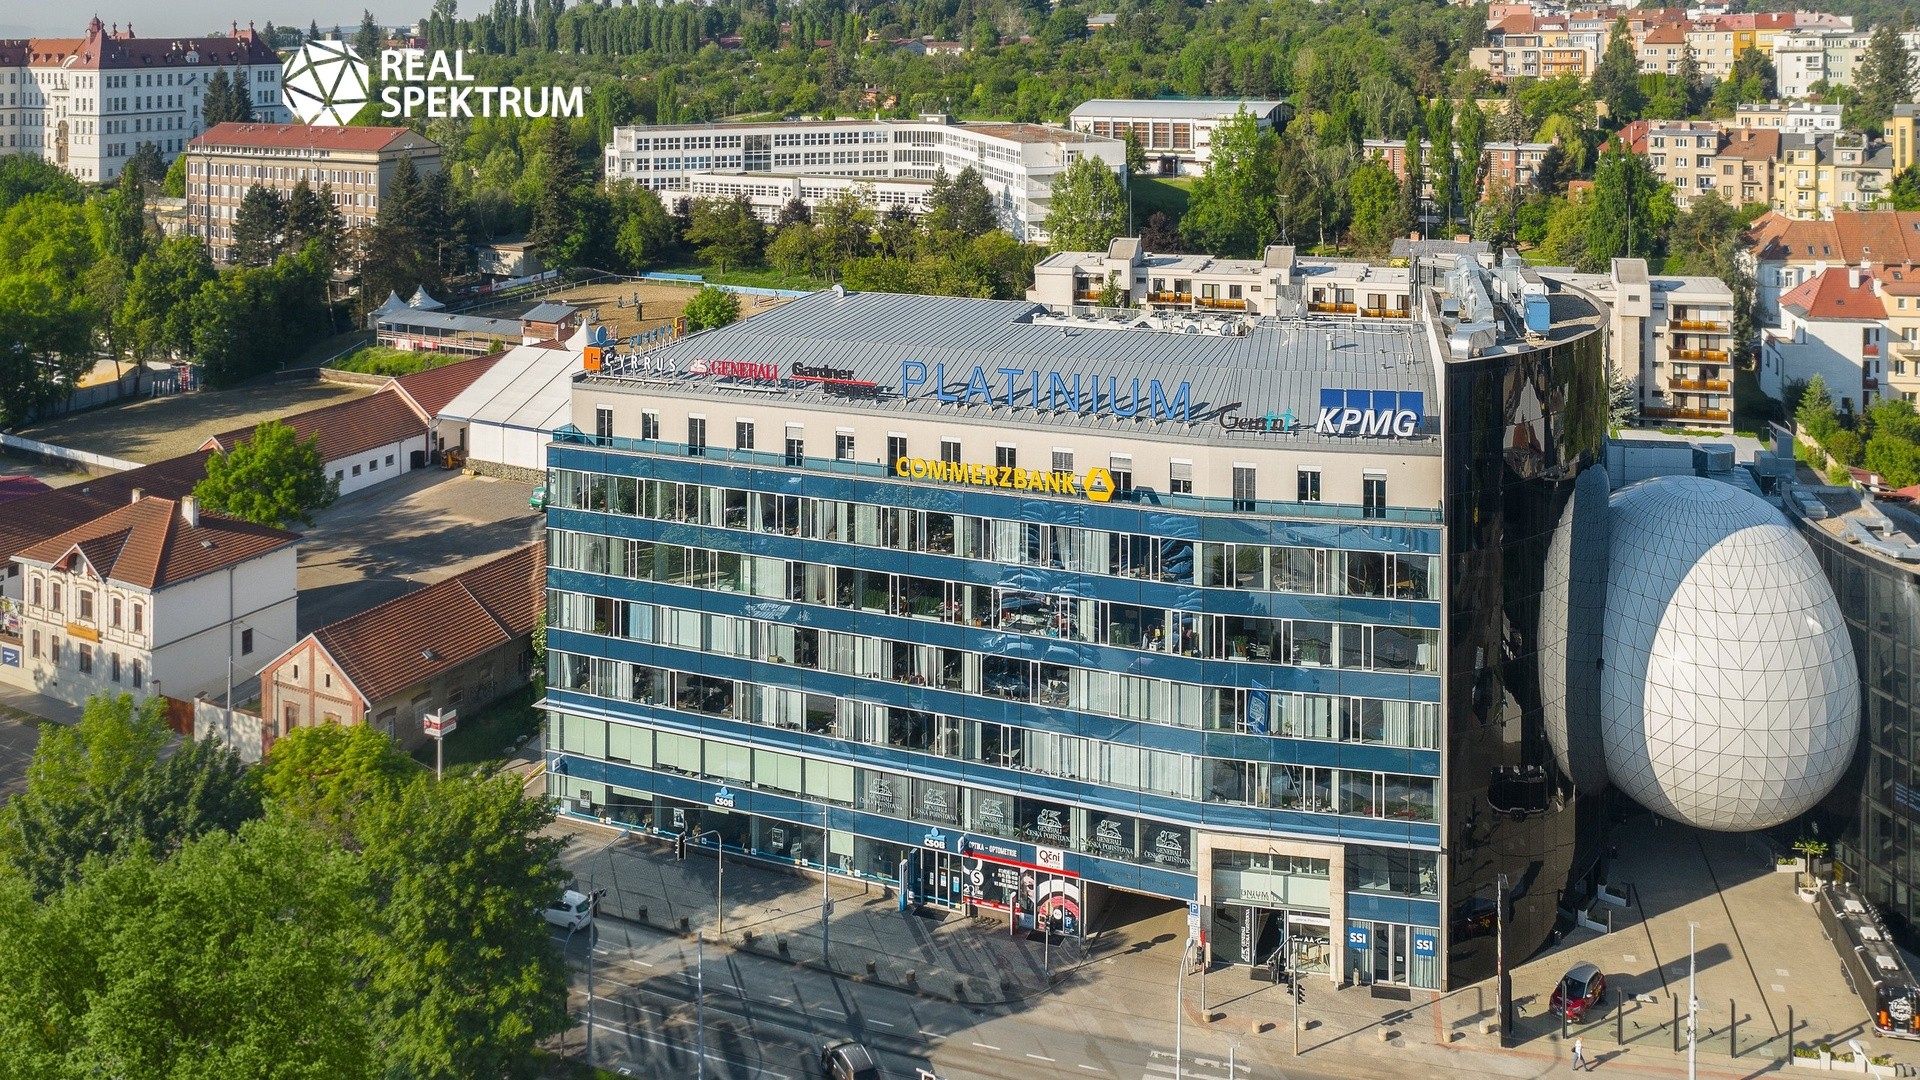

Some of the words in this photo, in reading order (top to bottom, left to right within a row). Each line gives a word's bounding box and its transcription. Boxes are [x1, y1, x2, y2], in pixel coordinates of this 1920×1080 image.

[605, 353, 676, 372] CYRRUS
[711, 360, 779, 380] GENERALI
[792, 361, 855, 380] Gardner
[902, 361, 1190, 421] PLATINIUM
[1315, 406, 1418, 437] KPMG
[896, 456, 1077, 495] COMMERZBANK
[715, 796, 734, 807] ČSOB
[1037, 825, 1062, 835] GENERALI
[924, 838, 945, 849] ČSOB
[968, 841, 985, 851] OPTIKA
[1096, 836, 1122, 846] GENERALI
[1156, 847, 1182, 857] GENERALI
[1191, 903, 1198, 912] P
[1350, 932, 1366, 944] SSI
[1416, 939, 1433, 951] SSI
